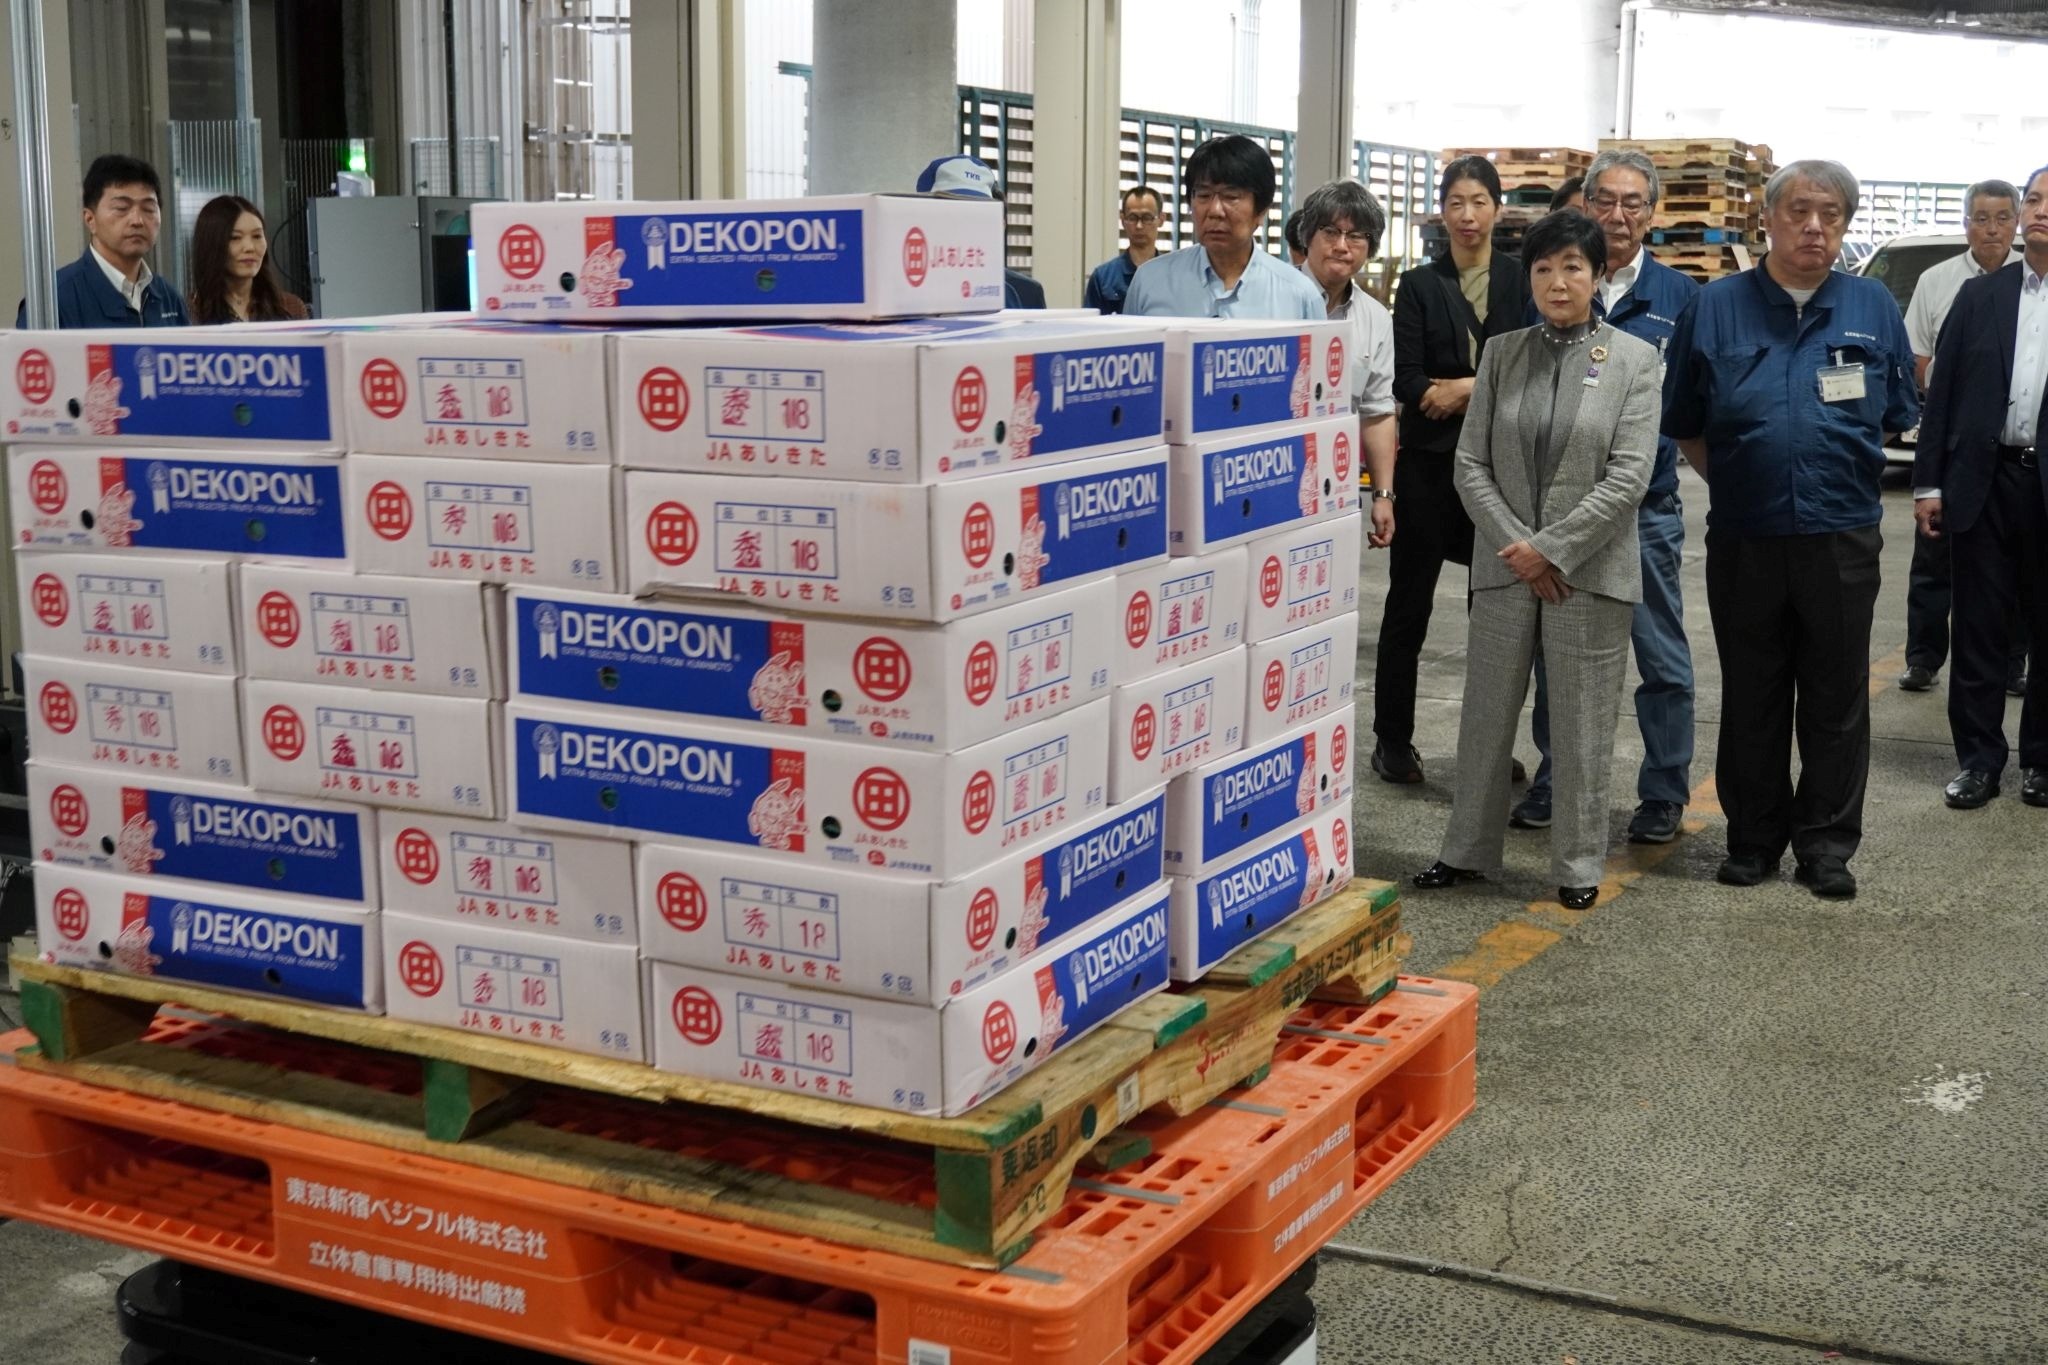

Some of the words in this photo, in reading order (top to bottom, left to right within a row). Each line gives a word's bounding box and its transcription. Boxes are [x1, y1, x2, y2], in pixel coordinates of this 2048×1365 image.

[670, 218, 836, 253] DEKOPON
[931, 245, 985, 268] JAあしきた
[158, 353, 300, 386] DEKOPON
[1066, 350, 1154, 393] DEKOPON
[1216, 343, 1285, 379] DEKOPON
[425, 429, 529, 447] JAあしきた
[706, 442, 825, 465] JAあしきた
[1225, 444, 1292, 487] DEKOPON
[170, 468, 314, 505] DEKOPON
[1071, 471, 1156, 520] DEKOPON
[430, 552, 534, 572] JAあしきた
[718, 578, 839, 602] JAあしきた
[561, 611, 732, 661] DEKOPON
[561, 732, 733, 785] DEKOPON
[1225, 748, 1291, 805] DEKOPON
[193, 803, 335, 849] DEKOPON
[1074, 806, 1157, 878] DEKOPON
[1220, 846, 1295, 909] DEKOPON
[457, 900, 558, 924] JAあしきた
[744, 907, 768, 939] 秀
[192, 910, 338, 960] DEKOPON
[1084, 907, 1166, 984] DEKOPON
[726, 950, 840, 980] JAあしきた
[461, 1014, 562, 1039] JAあしきた
[739, 1065, 852, 1095] JAあしきた
[285, 1176, 548, 1260] 東京新宿ベジフル株式会社
[308, 1240, 527, 1315] 立体倉庫専用持出厳禁
